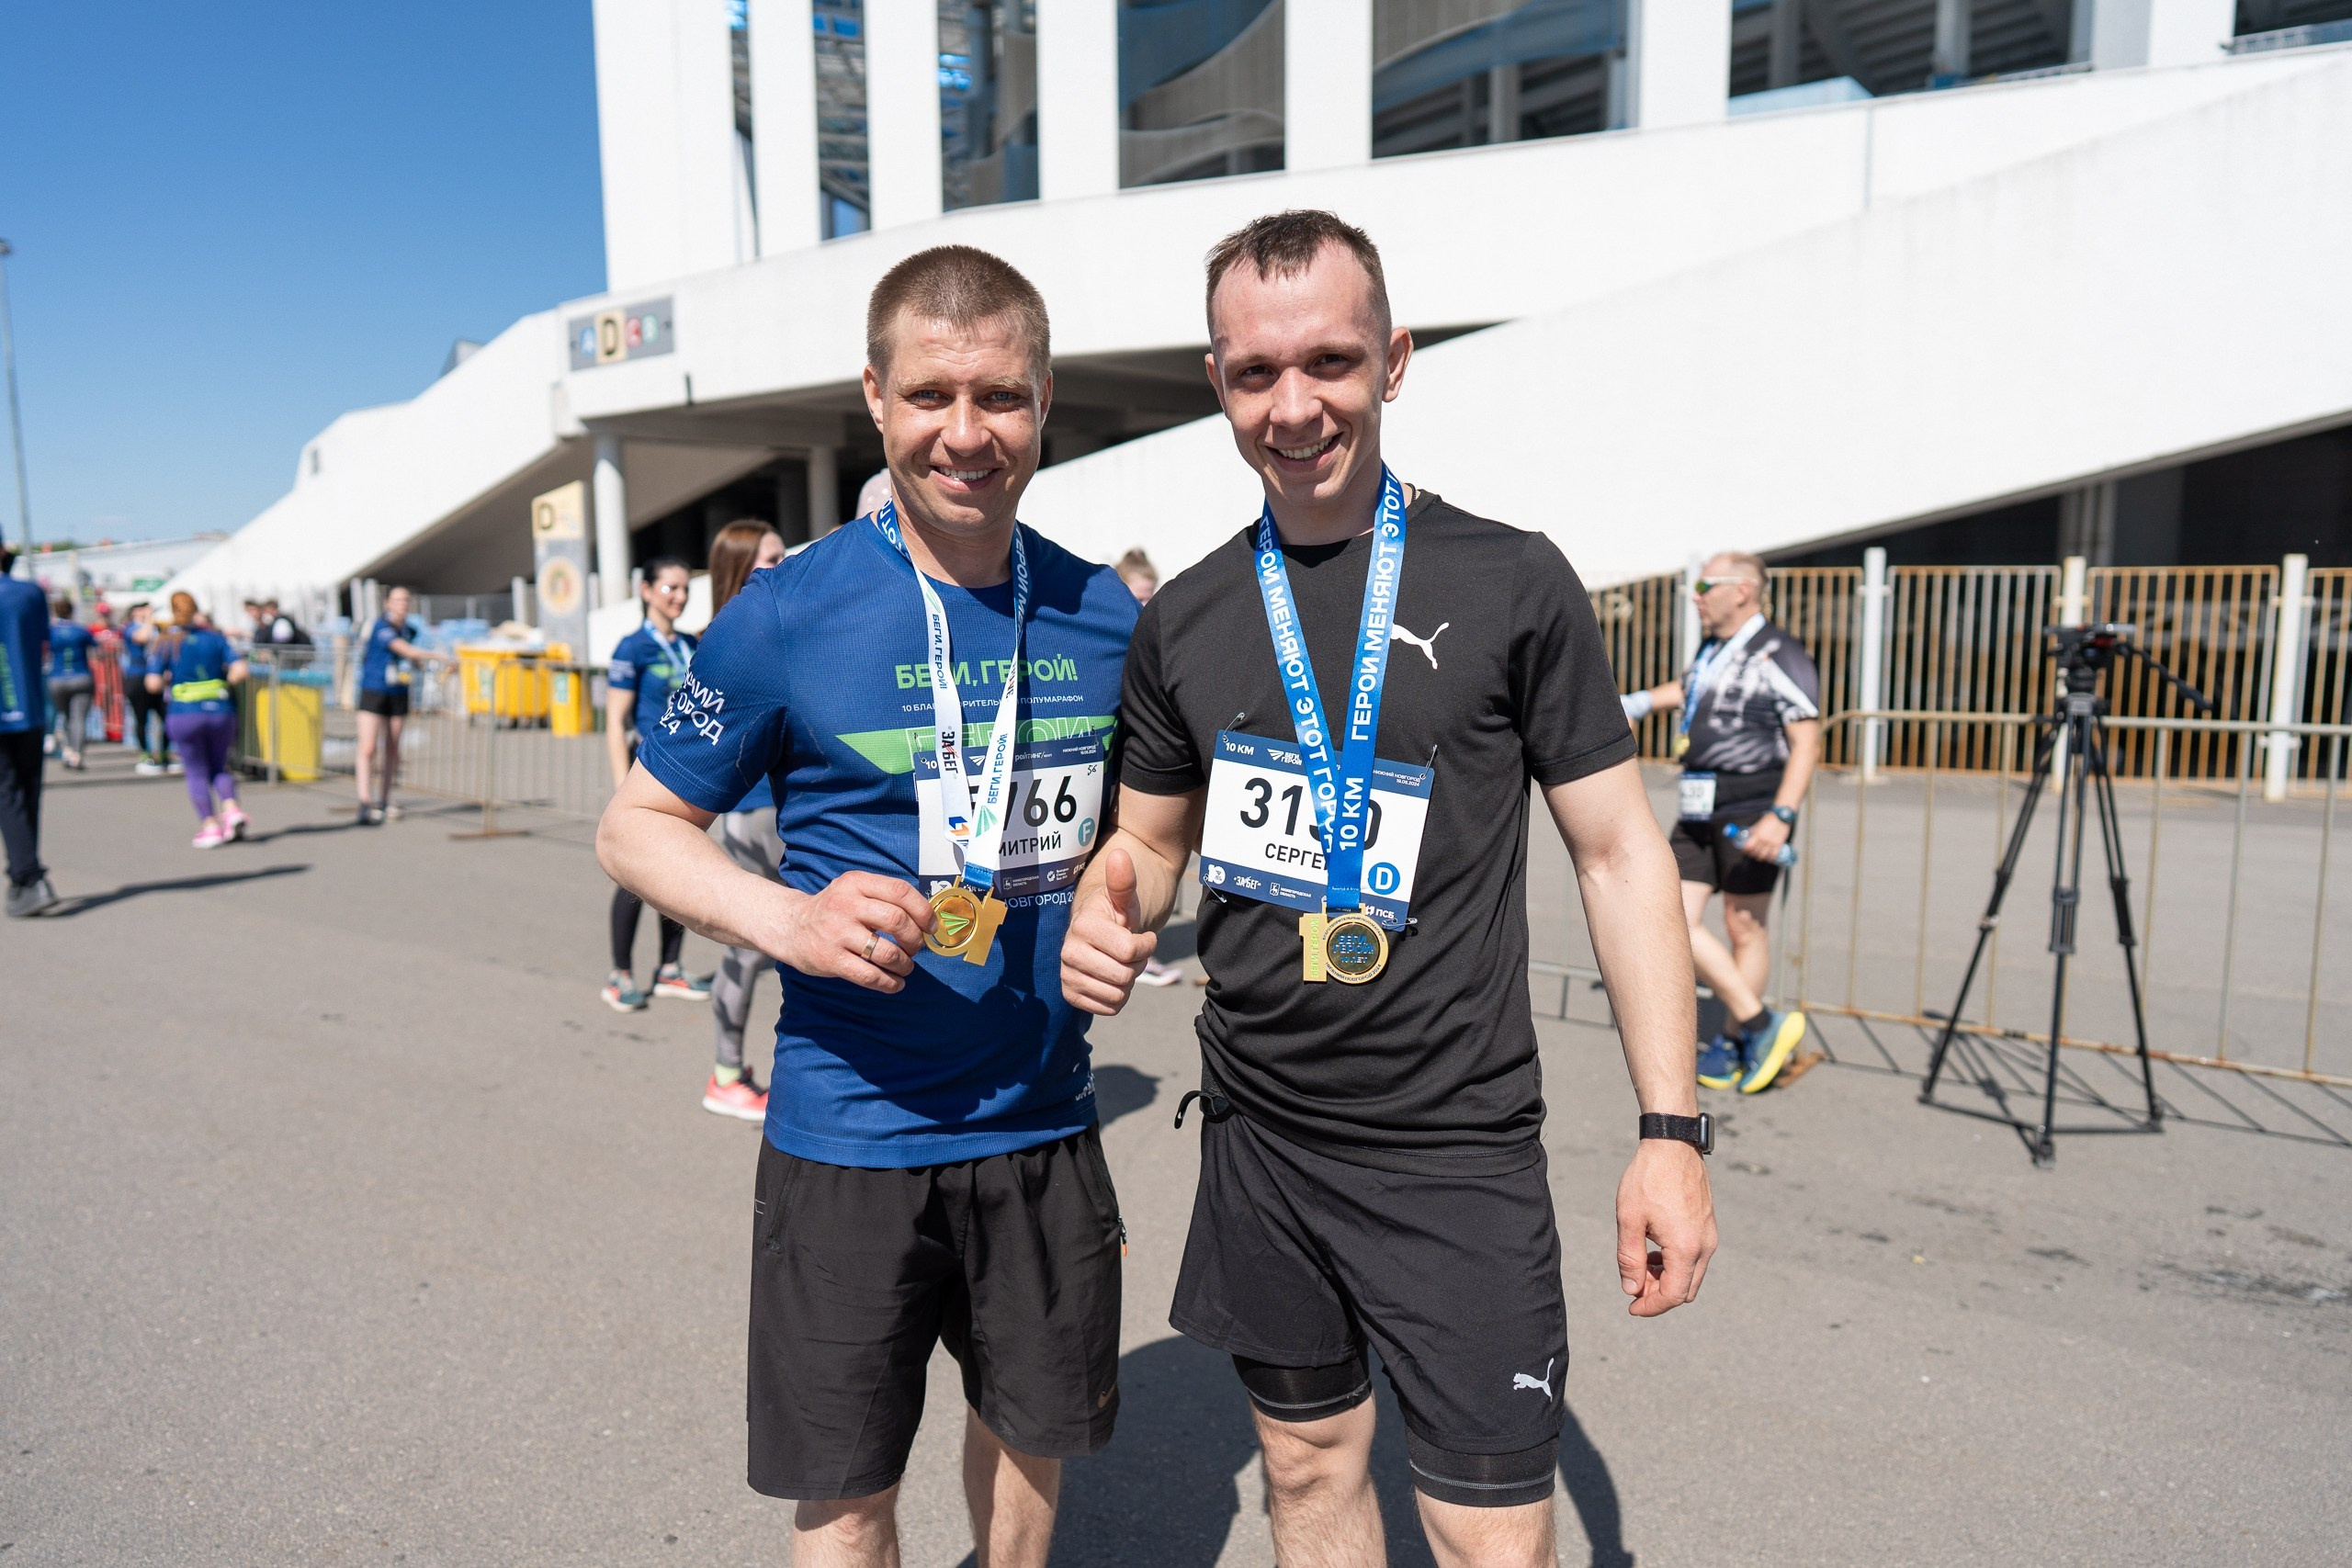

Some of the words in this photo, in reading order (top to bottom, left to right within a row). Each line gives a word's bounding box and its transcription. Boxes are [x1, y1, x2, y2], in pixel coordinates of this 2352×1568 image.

[603, 319, 617, 355] D
[1381, 482, 1401, 537] ЭТОТ
[1260, 515, 1280, 585] ГЕРОИ
[1364, 542, 1397, 651] МЕНЯЮТ
[1268, 585, 1309, 692] МЕНЯЮТ
[895, 661, 977, 690] БЕИ,
[1020, 694, 1083, 705] ПОЛУМАРАФОН
[1351, 657, 1379, 740] ГЕРОИ
[1296, 696, 1328, 761] ЭТОТ
[1226, 742, 1236, 752] 10
[1238, 745, 1255, 756] КМ
[969, 775, 1077, 831] 766
[1341, 777, 1364, 818] КМ
[999, 831, 1061, 857] МИТРИЙ
[1083, 821, 1092, 842] F
[1339, 824, 1359, 852] 10
[1265, 843, 1327, 871] СЕРГЕ
[1375, 867, 1393, 890] D
[1375, 909, 1395, 919] ПСБ
